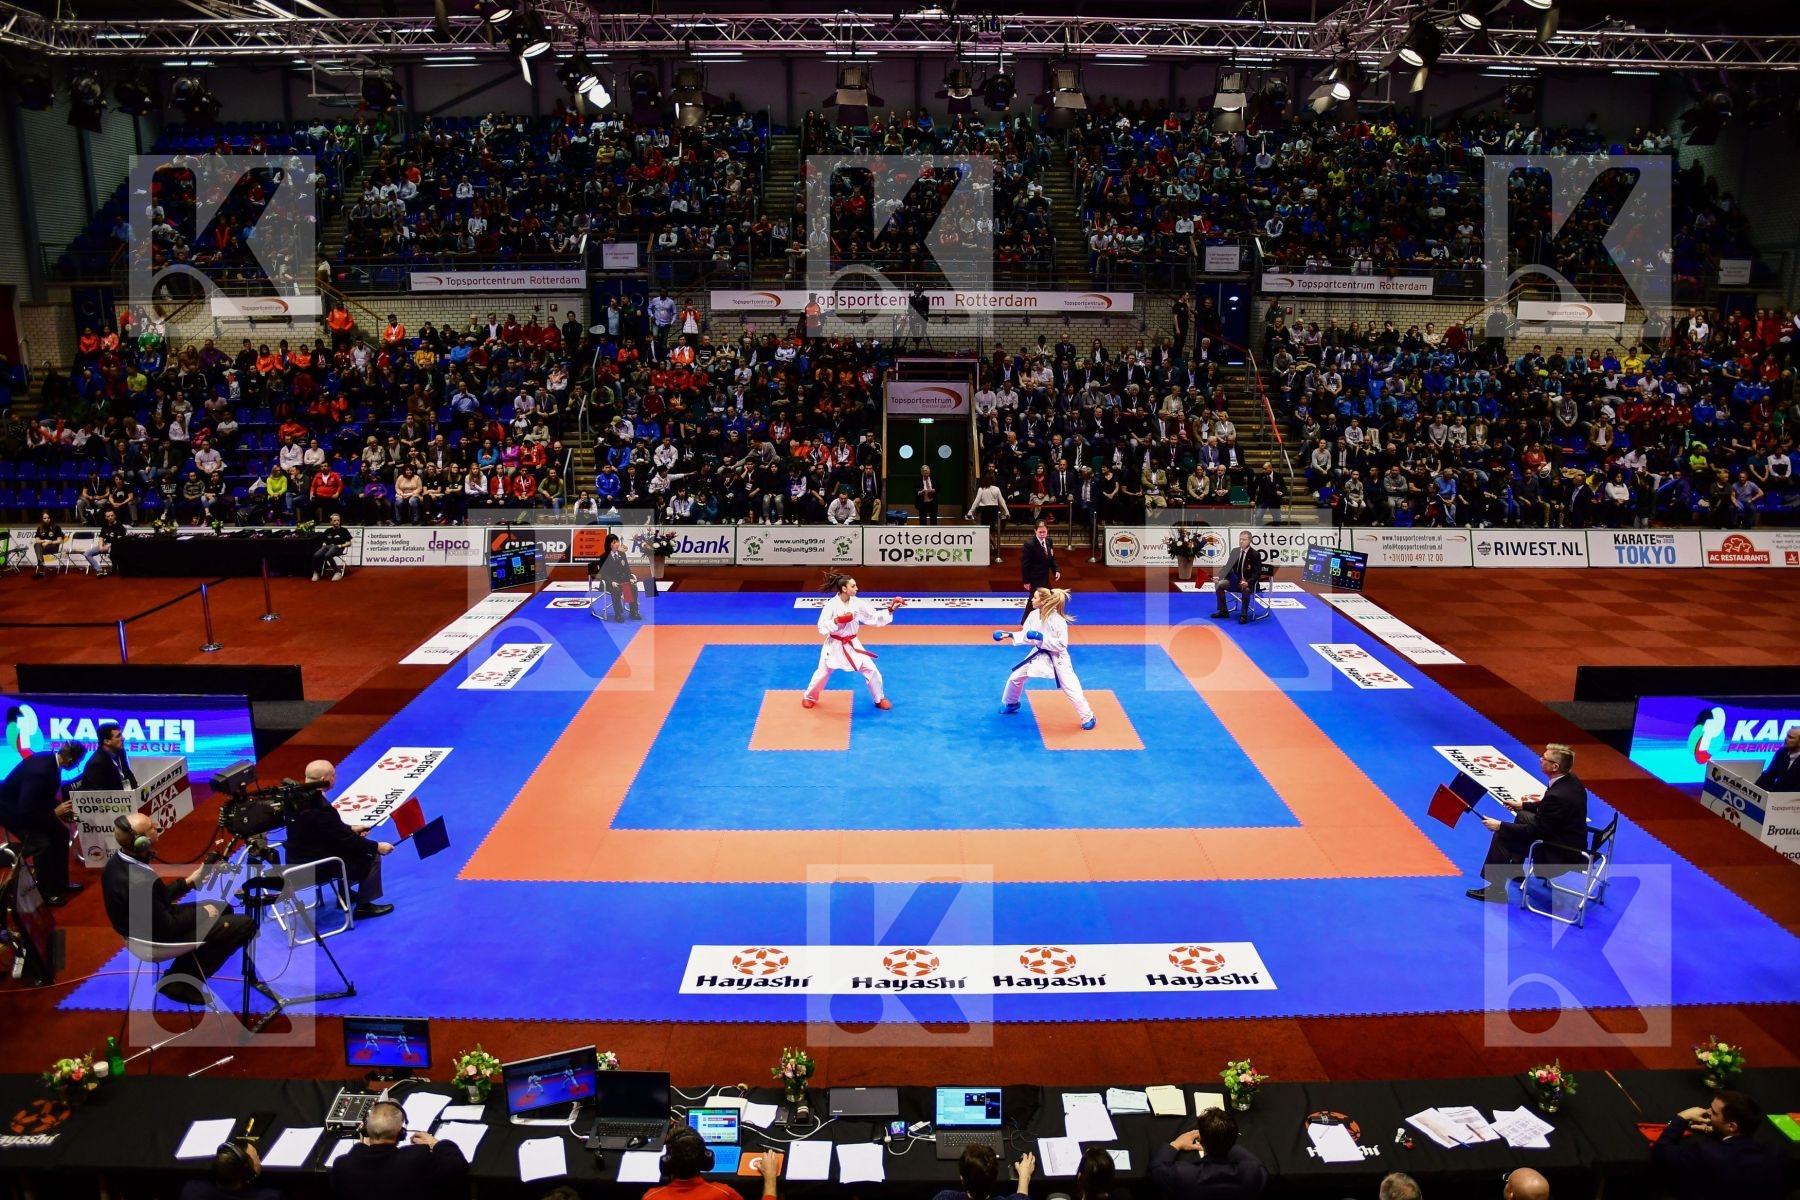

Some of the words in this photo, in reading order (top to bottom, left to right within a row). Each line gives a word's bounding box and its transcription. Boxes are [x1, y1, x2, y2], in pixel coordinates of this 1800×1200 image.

[446, 277, 525, 287] Topsportcentrum
[530, 276, 580, 285] Rotterdam
[1297, 279, 1375, 290] Topsportcentrum
[1379, 282, 1428, 291] Rotterdam
[955, 294, 1038, 307] Rotterdam
[891, 396, 952, 404] Topsportcentrum
[428, 531, 470, 561] dapco
[879, 532, 973, 545] rotterdam
[1250, 533, 1335, 545] otterdam
[1613, 534, 1656, 545] KARATE
[1382, 543, 1443, 551] info@topsportcentrum.nl
[1494, 542, 1583, 556] RIWEST.NL
[366, 555, 425, 563] www.dapco.nl
[879, 548, 973, 562] TOPSPORT
[1615, 546, 1676, 564] TOKYO
[50, 718, 195, 752] KAATE1
[404, 749, 444, 779] Hayashi
[1445, 749, 1491, 777] Hayashi
[150, 765, 182, 792] KARATE1
[75, 796, 131, 804] rotterdam
[150, 785, 180, 814] AKA
[360, 788, 405, 821] Hayashi
[1721, 790, 1746, 811] AO
[79, 805, 132, 813] TOPSPORT
[696, 975, 813, 990] Hayashi
[851, 976, 967, 991] Hayashi
[993, 973, 1108, 989] Hayashi
[1146, 972, 1259, 988] Hayashi
[0, 1132, 61, 1147] ayashi
